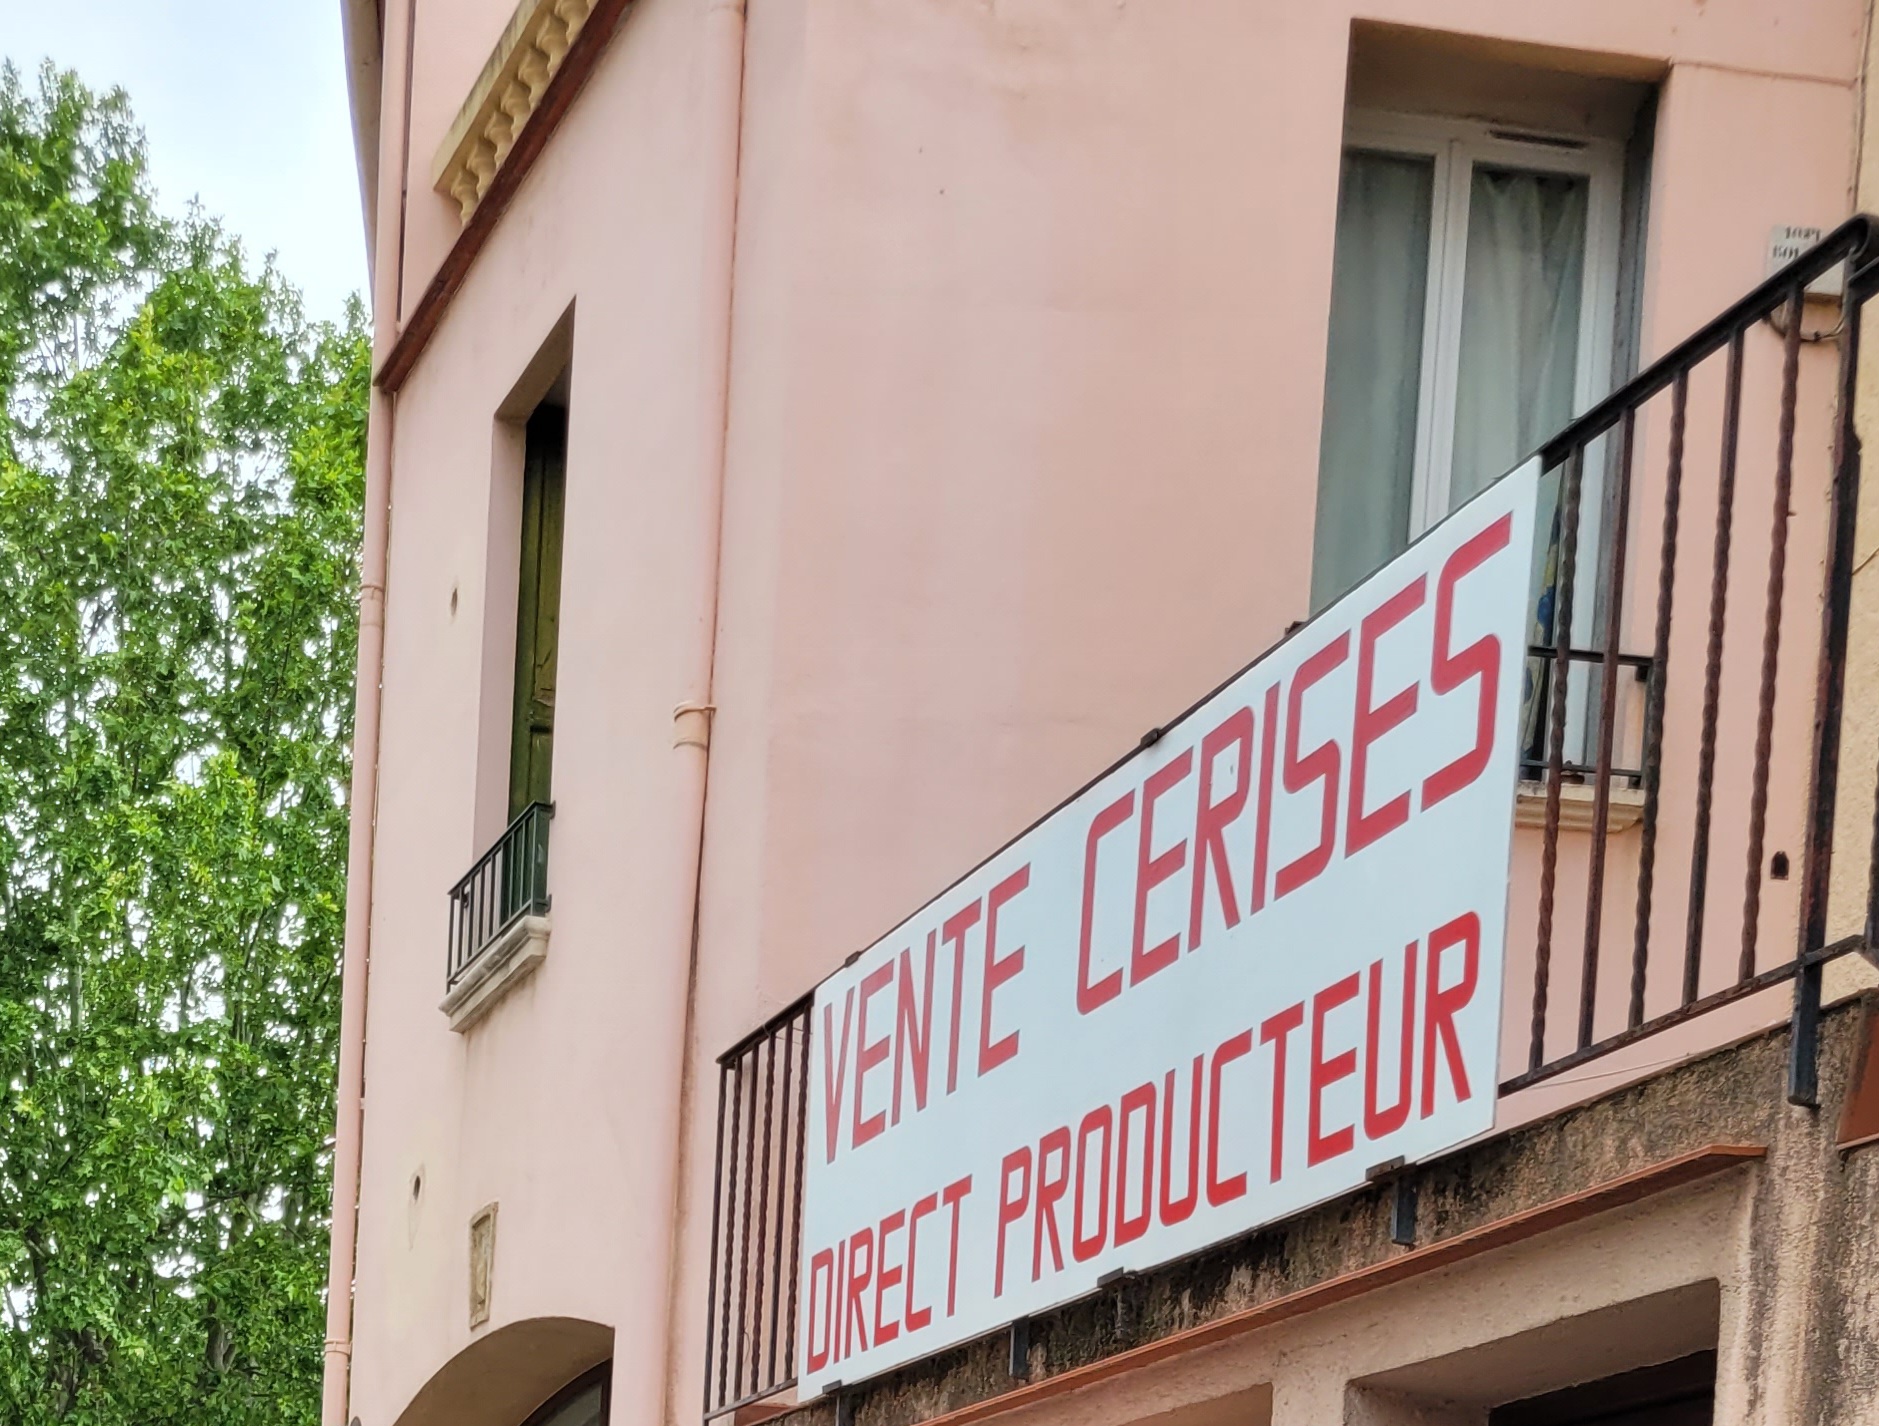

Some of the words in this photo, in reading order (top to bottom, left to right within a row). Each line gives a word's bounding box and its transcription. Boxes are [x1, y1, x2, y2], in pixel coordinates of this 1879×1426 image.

[822, 860, 1032, 1164] VENTE
[1076, 511, 1515, 1016] CERISES
[806, 1173, 973, 1376] DIRECT
[993, 910, 1482, 1298] PRODUCTEUR
